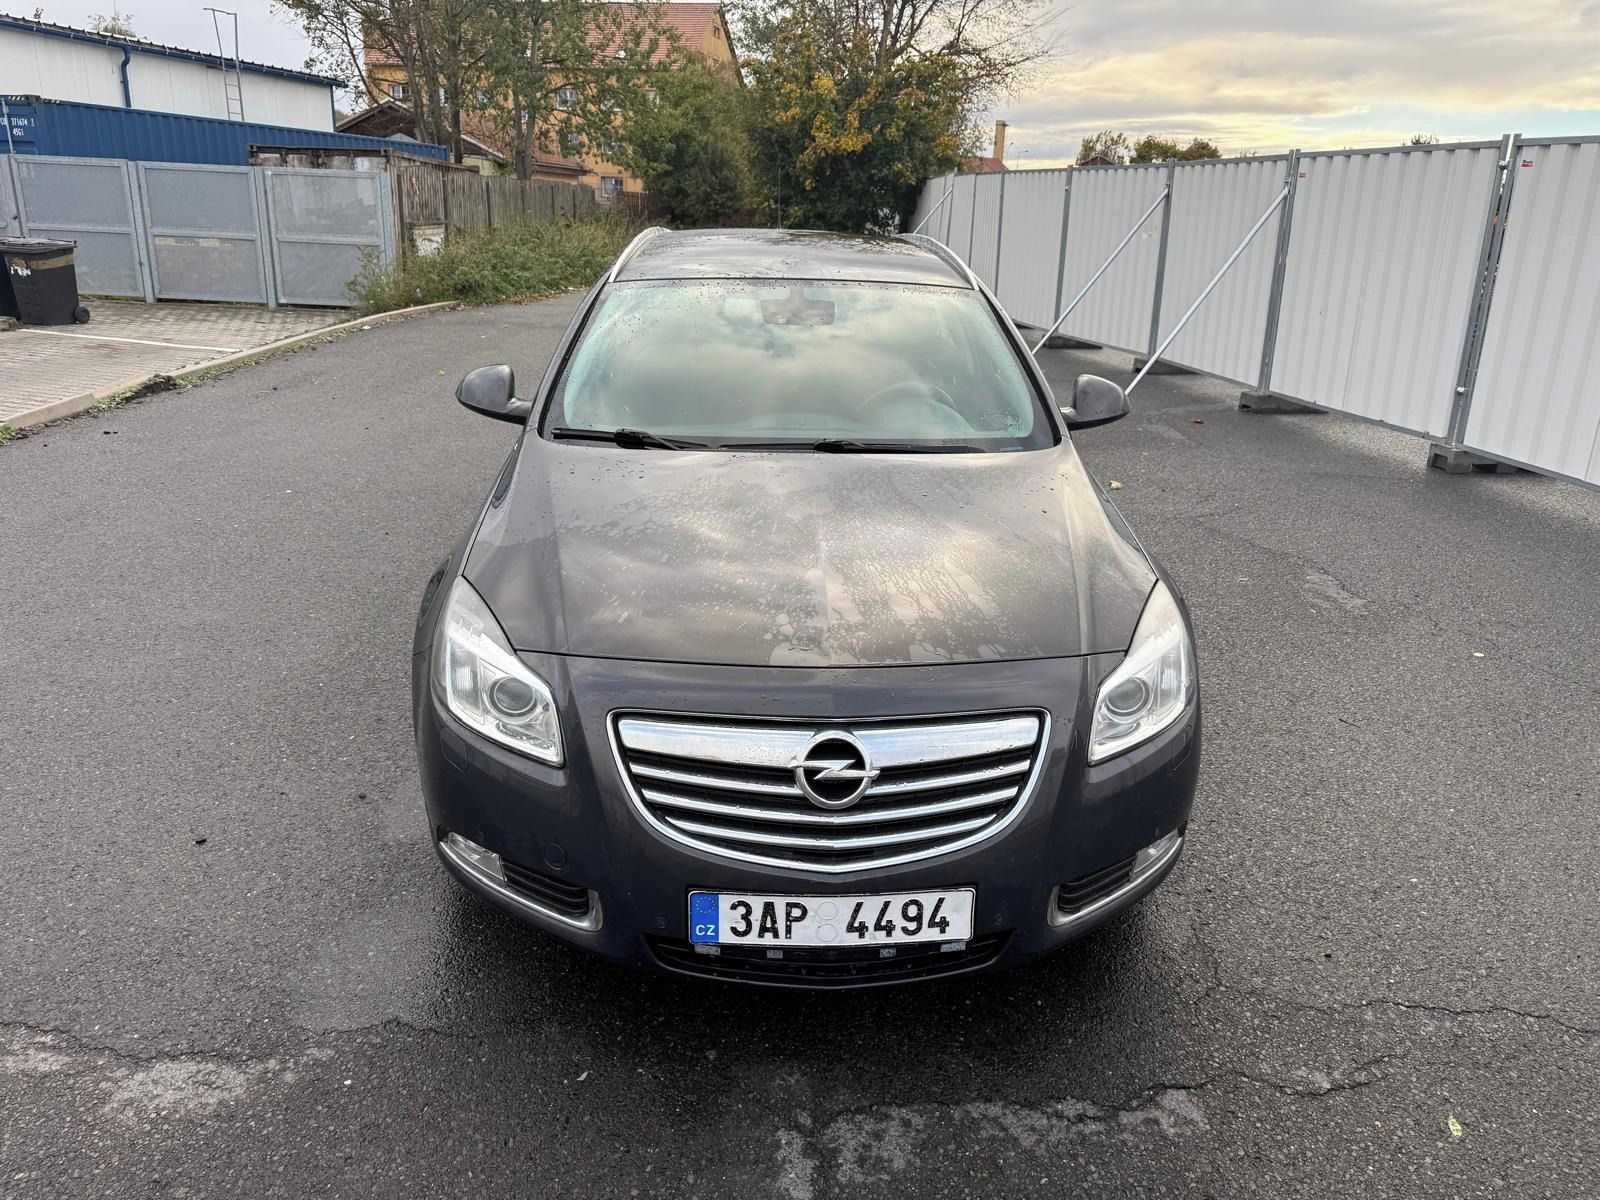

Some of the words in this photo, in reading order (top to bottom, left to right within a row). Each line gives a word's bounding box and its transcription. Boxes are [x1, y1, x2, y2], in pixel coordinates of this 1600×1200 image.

[695, 924, 716, 937] CZ
[729, 899, 808, 940] 3AP
[845, 896, 950, 939] 4494
